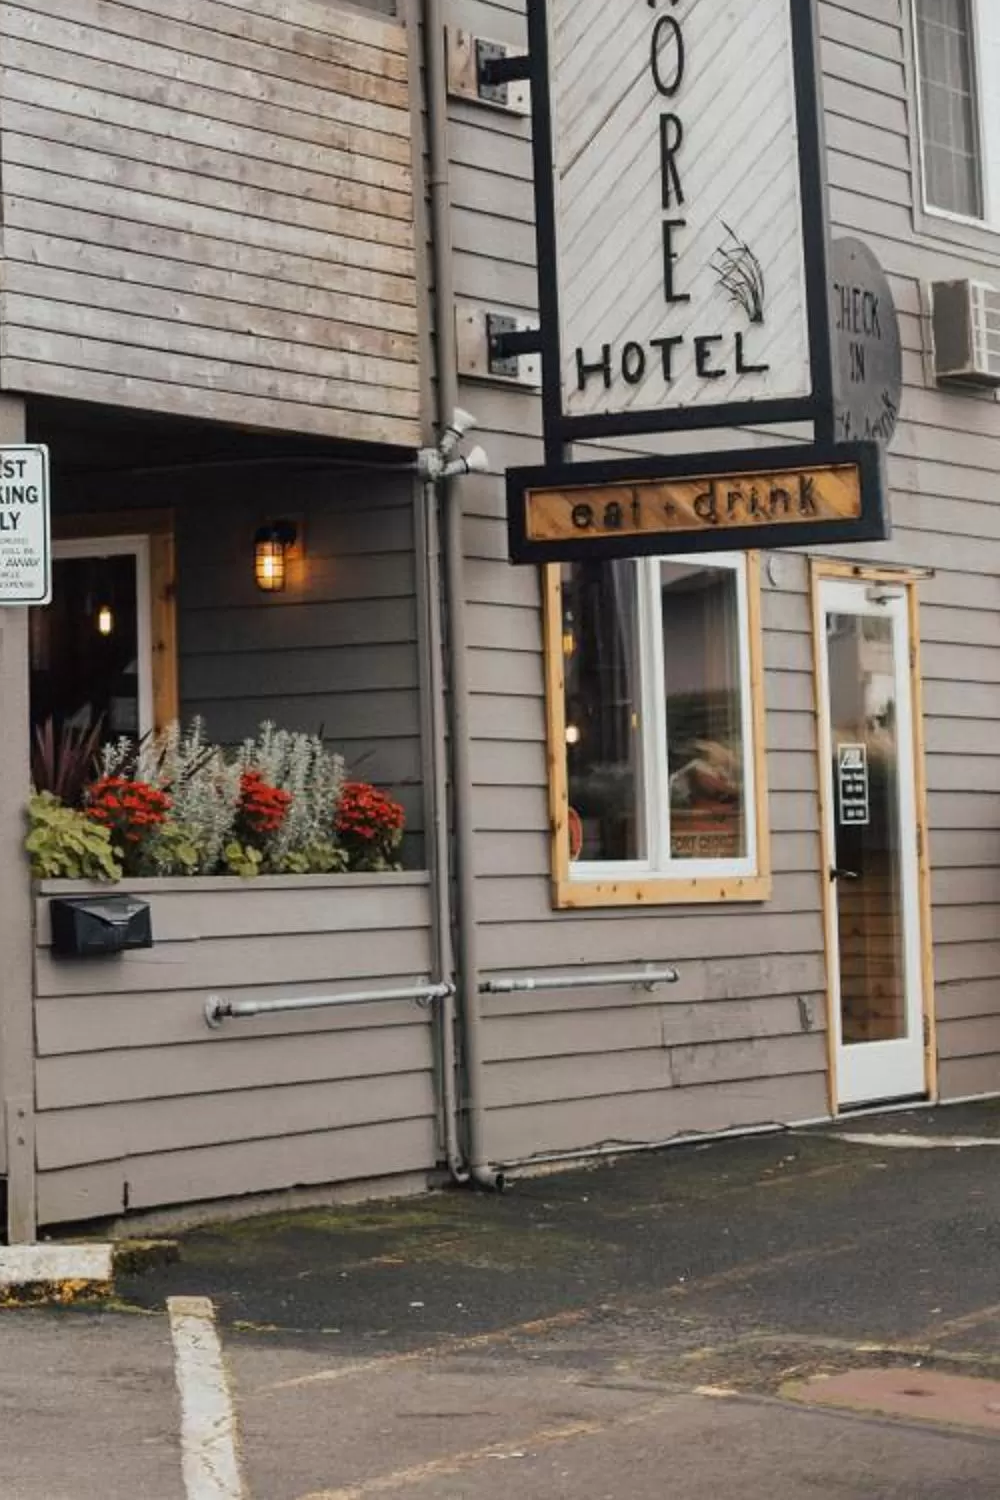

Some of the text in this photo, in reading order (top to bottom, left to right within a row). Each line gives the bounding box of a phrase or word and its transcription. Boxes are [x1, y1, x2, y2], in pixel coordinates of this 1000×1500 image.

[575, 331, 770, 390] HOTEL
[849, 341, 865, 384] IN
[571, 484, 640, 530] eat
[692, 473, 818, 525] drink
[5, 557, 41, 568] AWAY
